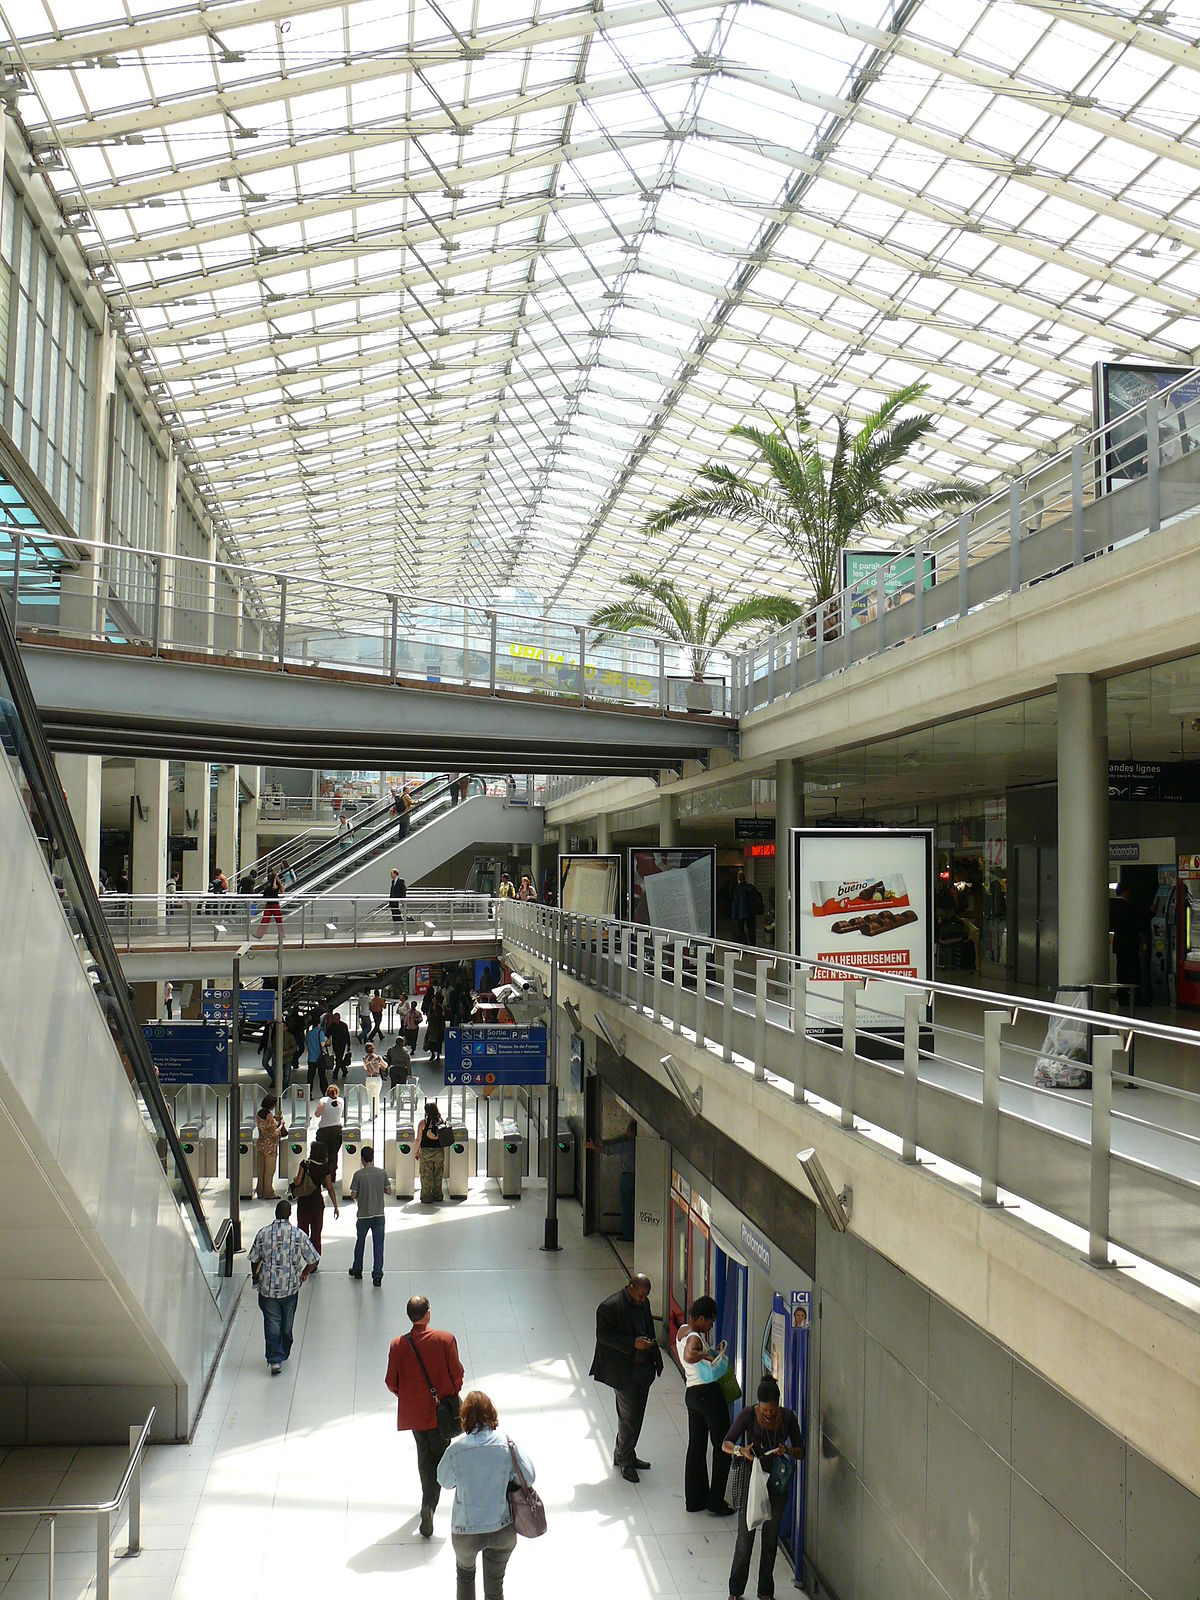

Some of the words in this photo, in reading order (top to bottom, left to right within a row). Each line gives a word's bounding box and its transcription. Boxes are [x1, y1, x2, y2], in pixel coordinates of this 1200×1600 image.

[1109, 763, 1134, 773] andes
[1136, 764, 1160, 774] lignes
[1109, 845, 1138, 856] hotomaton
[837, 882, 868, 896] bueno
[821, 953, 908, 966] MALHEUREUSEMENT
[815, 969, 829, 979] ECI
[793, 1292, 808, 1303] ICI
